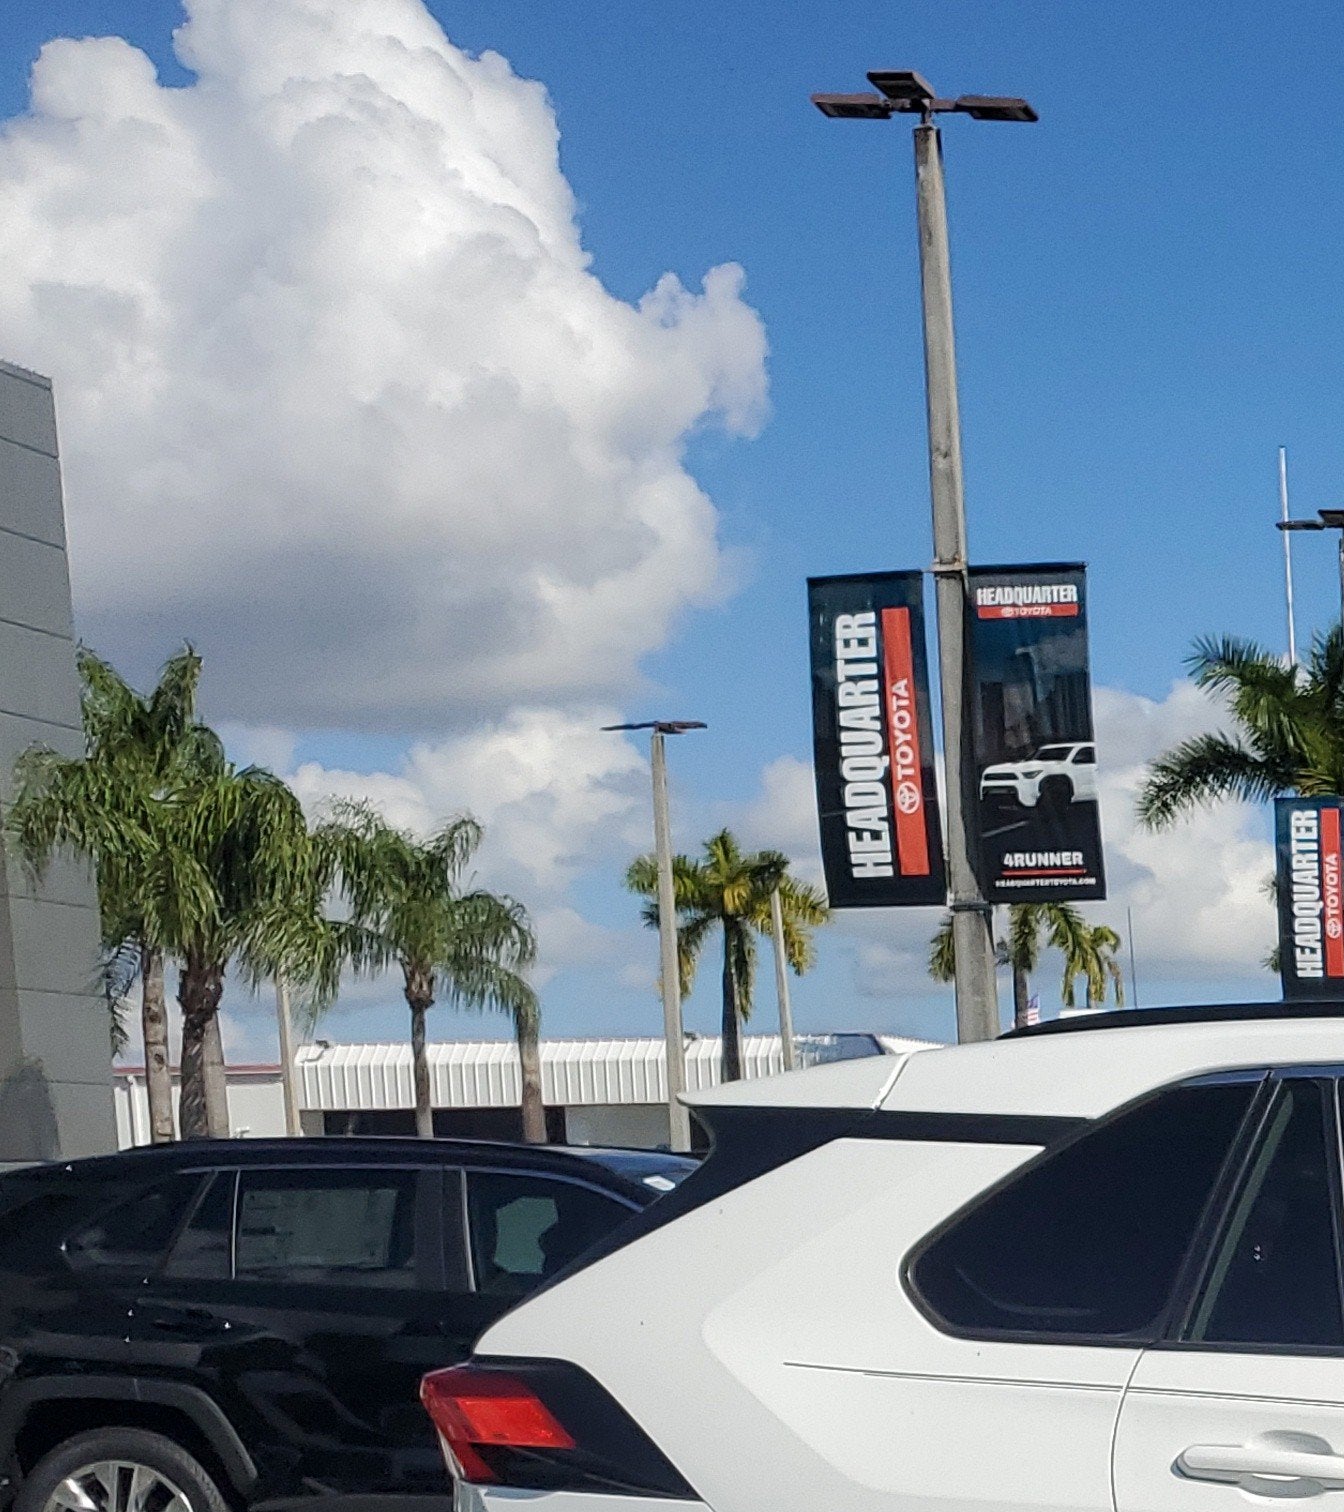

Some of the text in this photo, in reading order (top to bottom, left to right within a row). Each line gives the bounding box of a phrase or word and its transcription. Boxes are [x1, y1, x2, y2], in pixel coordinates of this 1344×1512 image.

[977, 585, 1078, 606] HEADQUARTER
[835, 611, 893, 879] HEADQUARTER
[892, 678, 919, 781] TOYOTA
[1003, 851, 1084, 867] 4RUNNER
[1291, 810, 1324, 978] HEADQUARTER
[1325, 853, 1341, 913] TOYOTA
